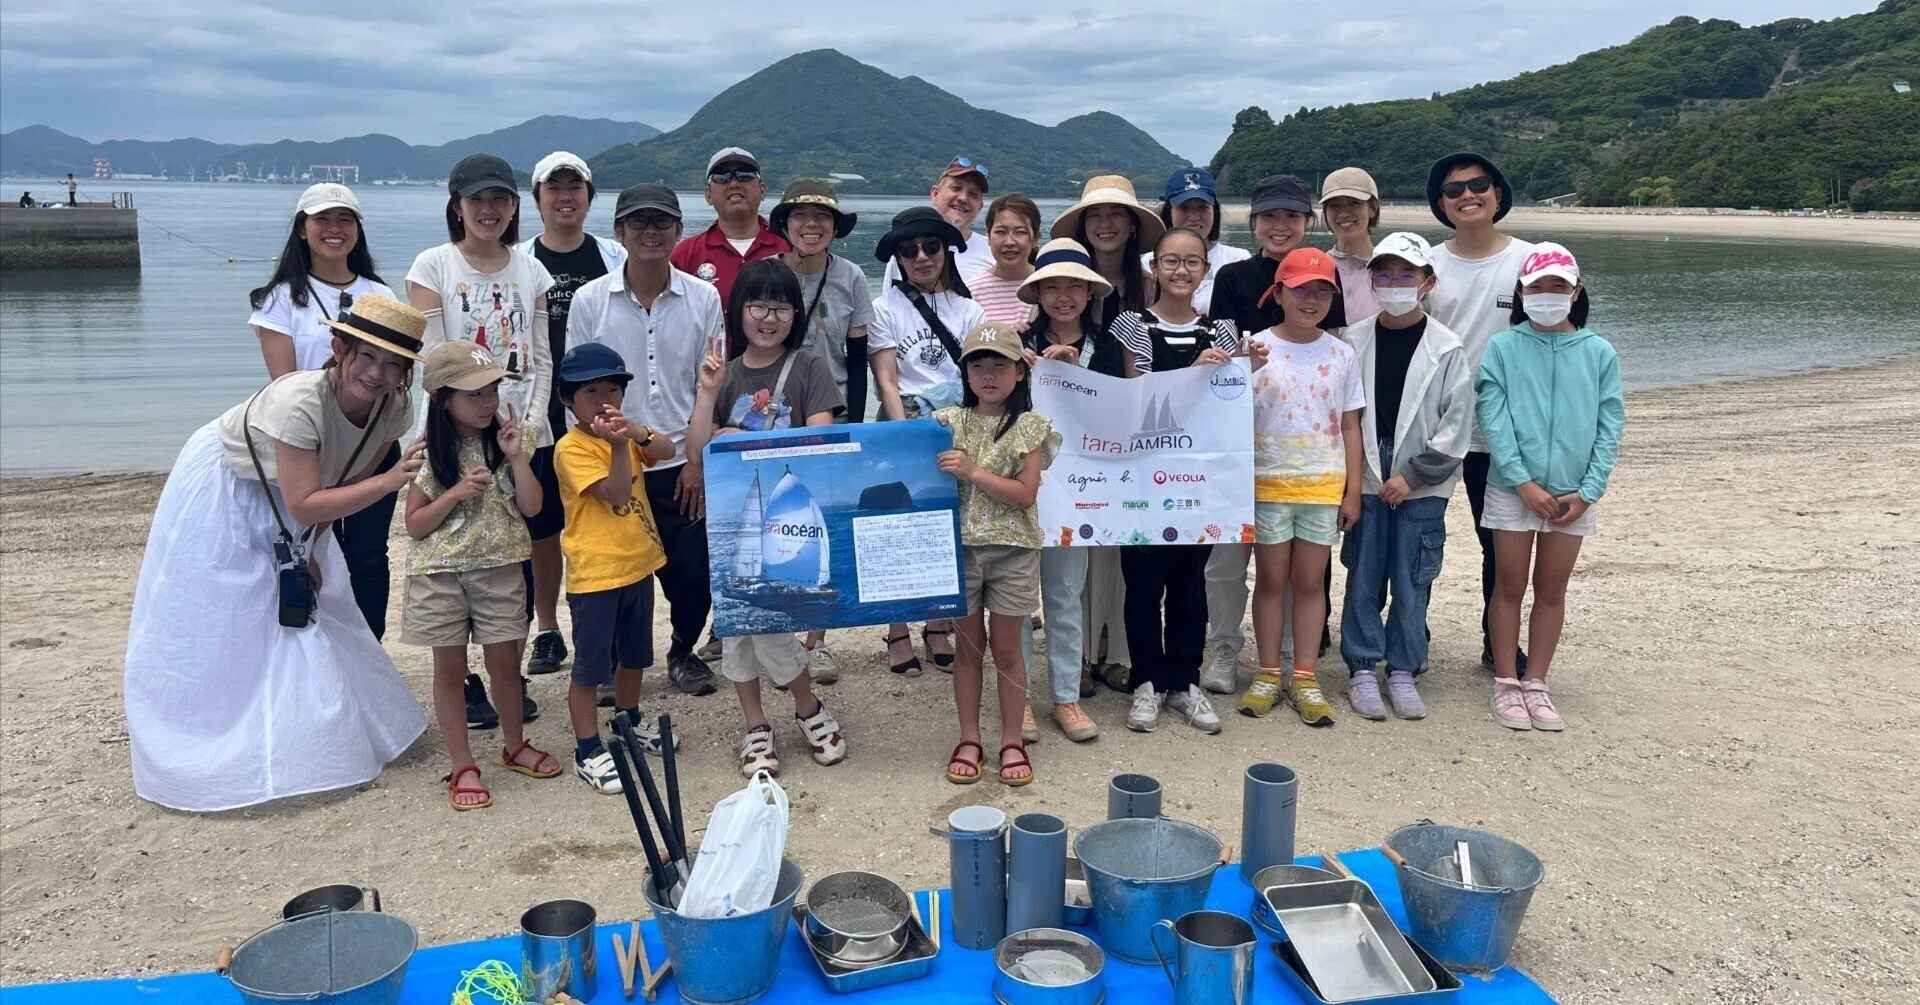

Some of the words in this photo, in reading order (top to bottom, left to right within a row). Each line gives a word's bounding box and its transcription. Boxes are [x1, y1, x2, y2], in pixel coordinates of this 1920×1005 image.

[548, 290, 564, 299] Life
[980, 327, 997, 342] NY
[1168, 473, 1206, 482] VEOLIA
[1122, 500, 1149, 508] maruni
